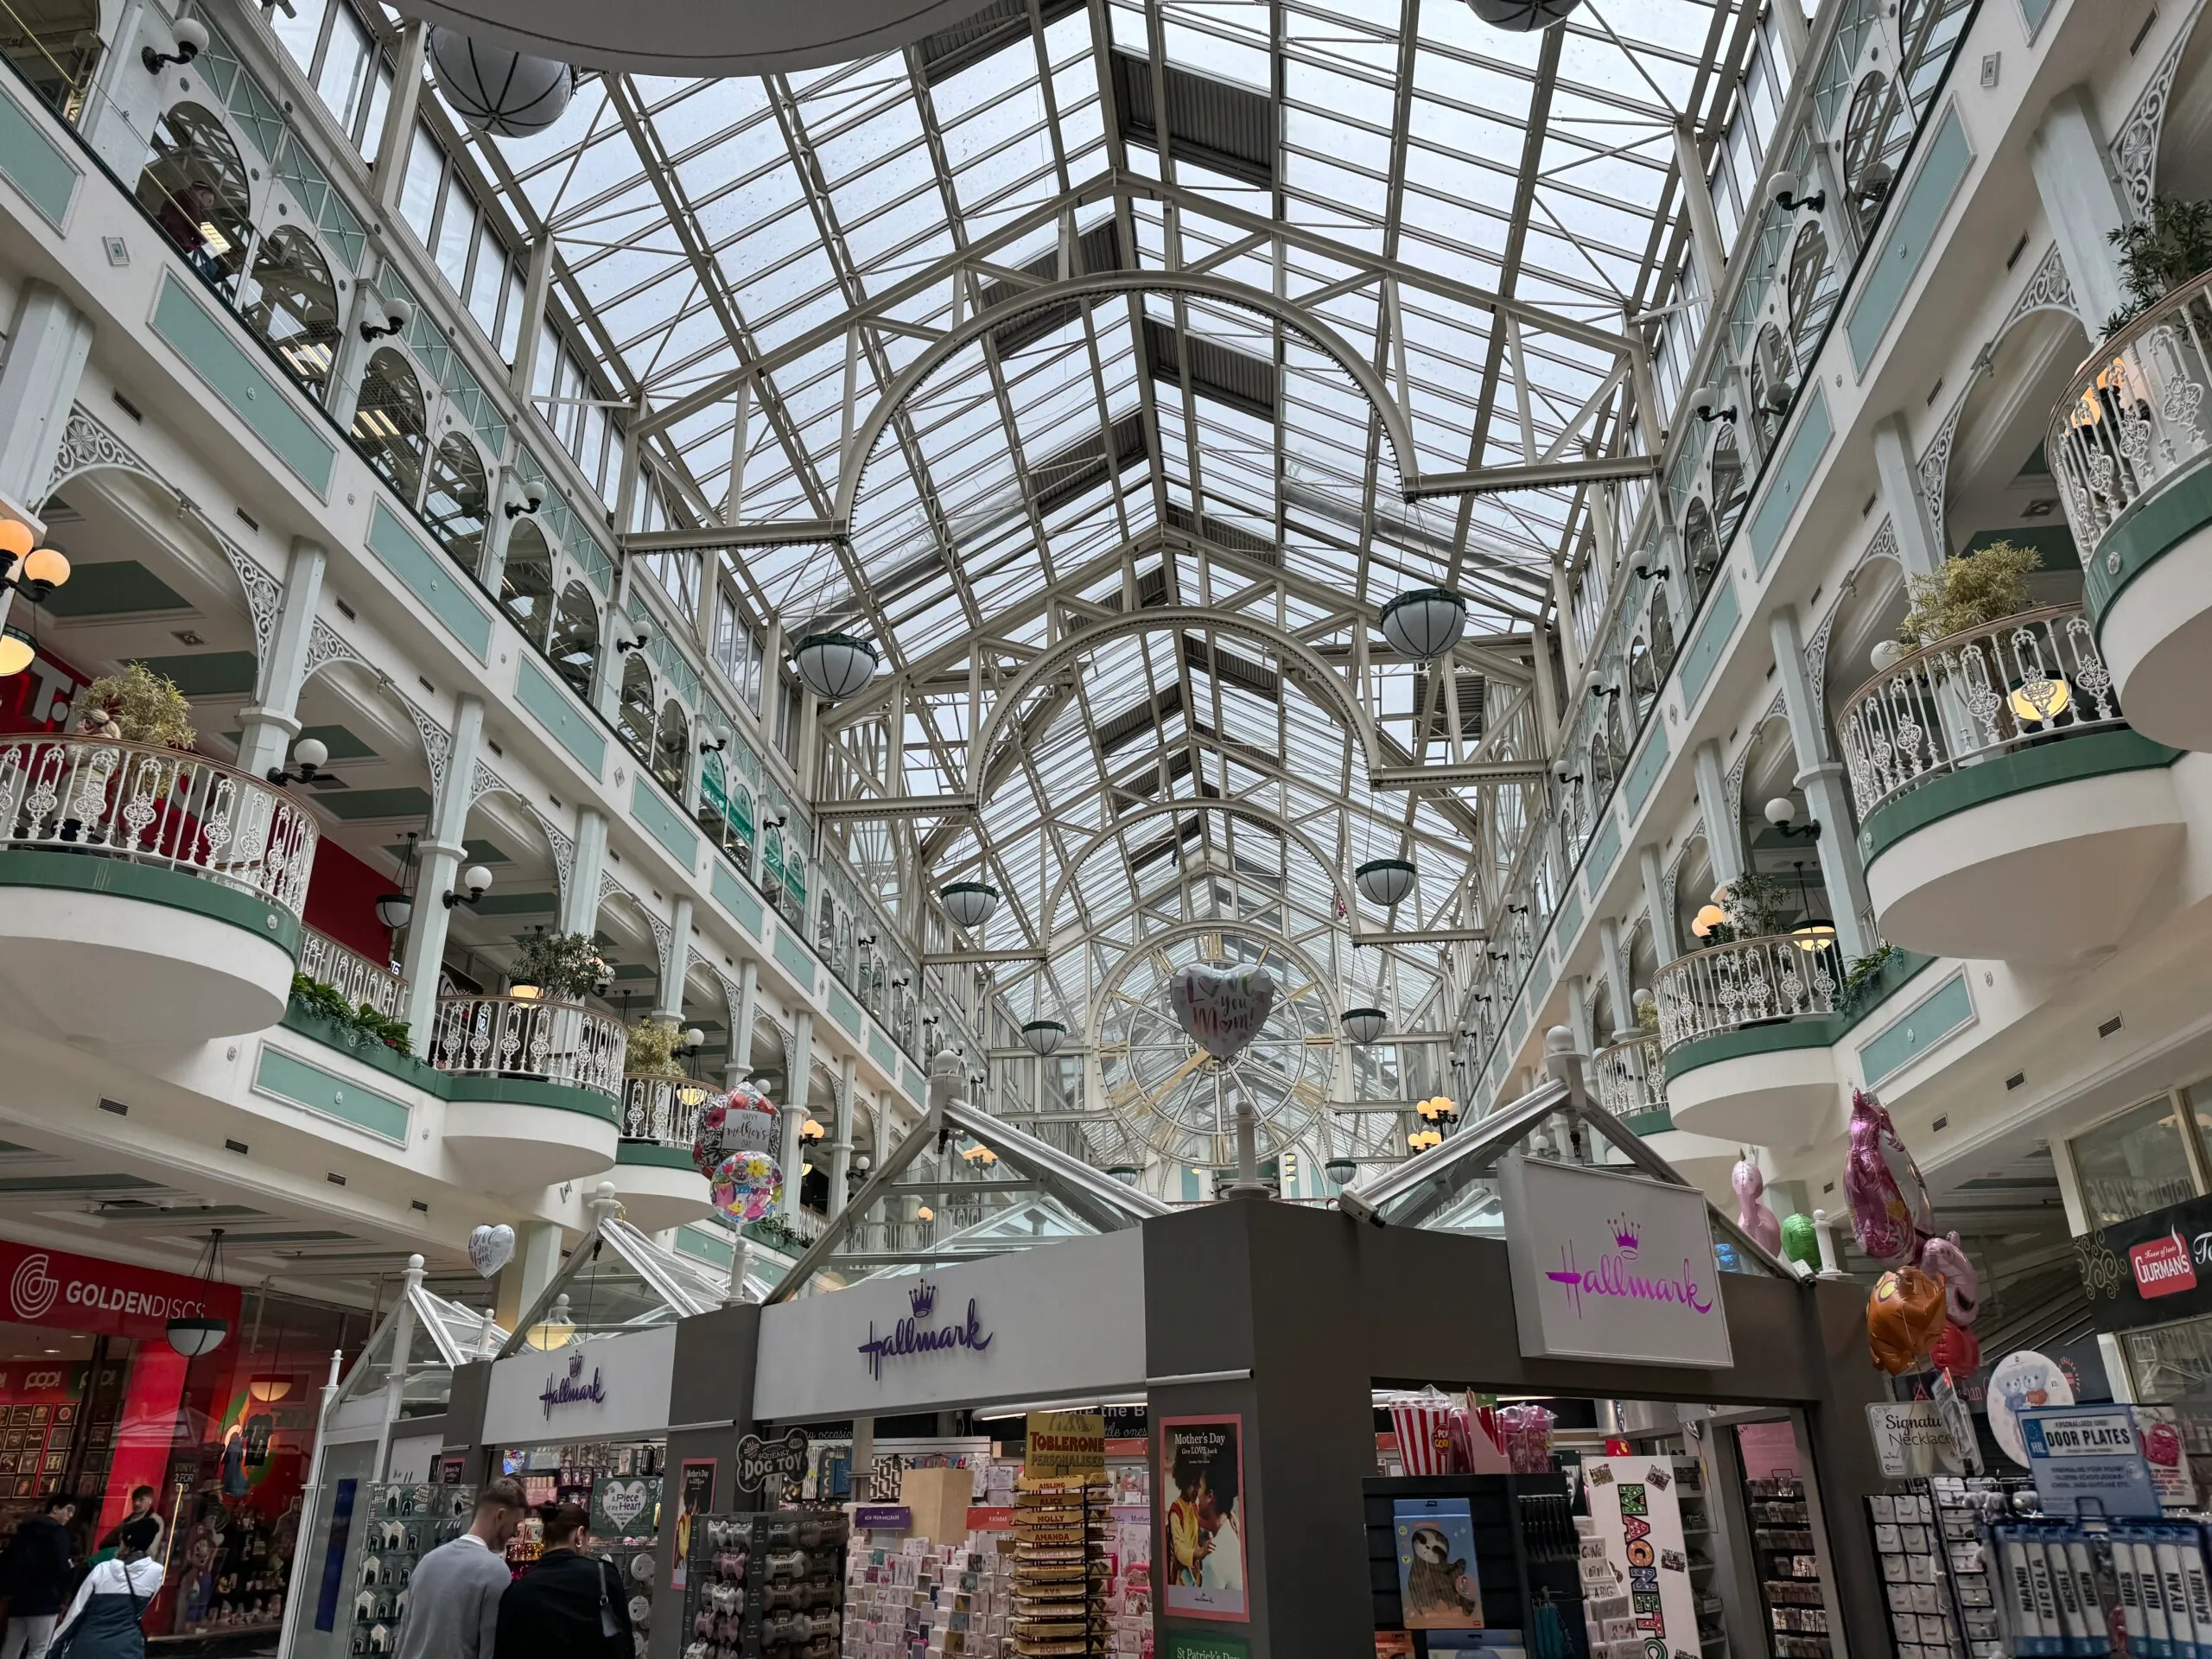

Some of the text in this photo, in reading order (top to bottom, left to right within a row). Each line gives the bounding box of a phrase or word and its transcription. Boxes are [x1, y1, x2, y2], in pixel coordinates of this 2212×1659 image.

[1220, 995, 1247, 1017] you
[741, 1112, 758, 1121] HAPPY
[725, 1121, 769, 1141] mother's
[1545, 1239, 1713, 1319] Hallmark
[857, 1298, 994, 1381] Hallmark
[539, 1367, 606, 1421] Hallmark
[1135, 1407, 1146, 1417] B
[1123, 1425, 1148, 1437] ones
[1885, 1414, 1943, 1435] Signatu
[818, 1427, 853, 1440] occasio
[1174, 1432, 1225, 1446] Mother's Day
[2046, 1428, 2131, 1447] DOOR PLATES
[1029, 1431, 1105, 1453] TOBLERONE
[758, 1449, 790, 1460] SQUEAKY
[1191, 1446, 1207, 1455] LOVE
[745, 1459, 773, 1481] DOG
[777, 1451, 803, 1471] TOY
[1031, 1453, 1105, 1468] PERSONALISED
[175, 1473, 194, 1483] 2 FOR
[616, 1494, 639, 1503] Piece
[619, 1502, 641, 1511] Heart
[1035, 1533, 1070, 1541] AMANDA
[2032, 1559, 2054, 1619] NICOLA
[2165, 1573, 2186, 1612] RYAN
[1177, 1647, 1185, 1659] St
[1186, 1648, 1221, 1659] Patrick's
